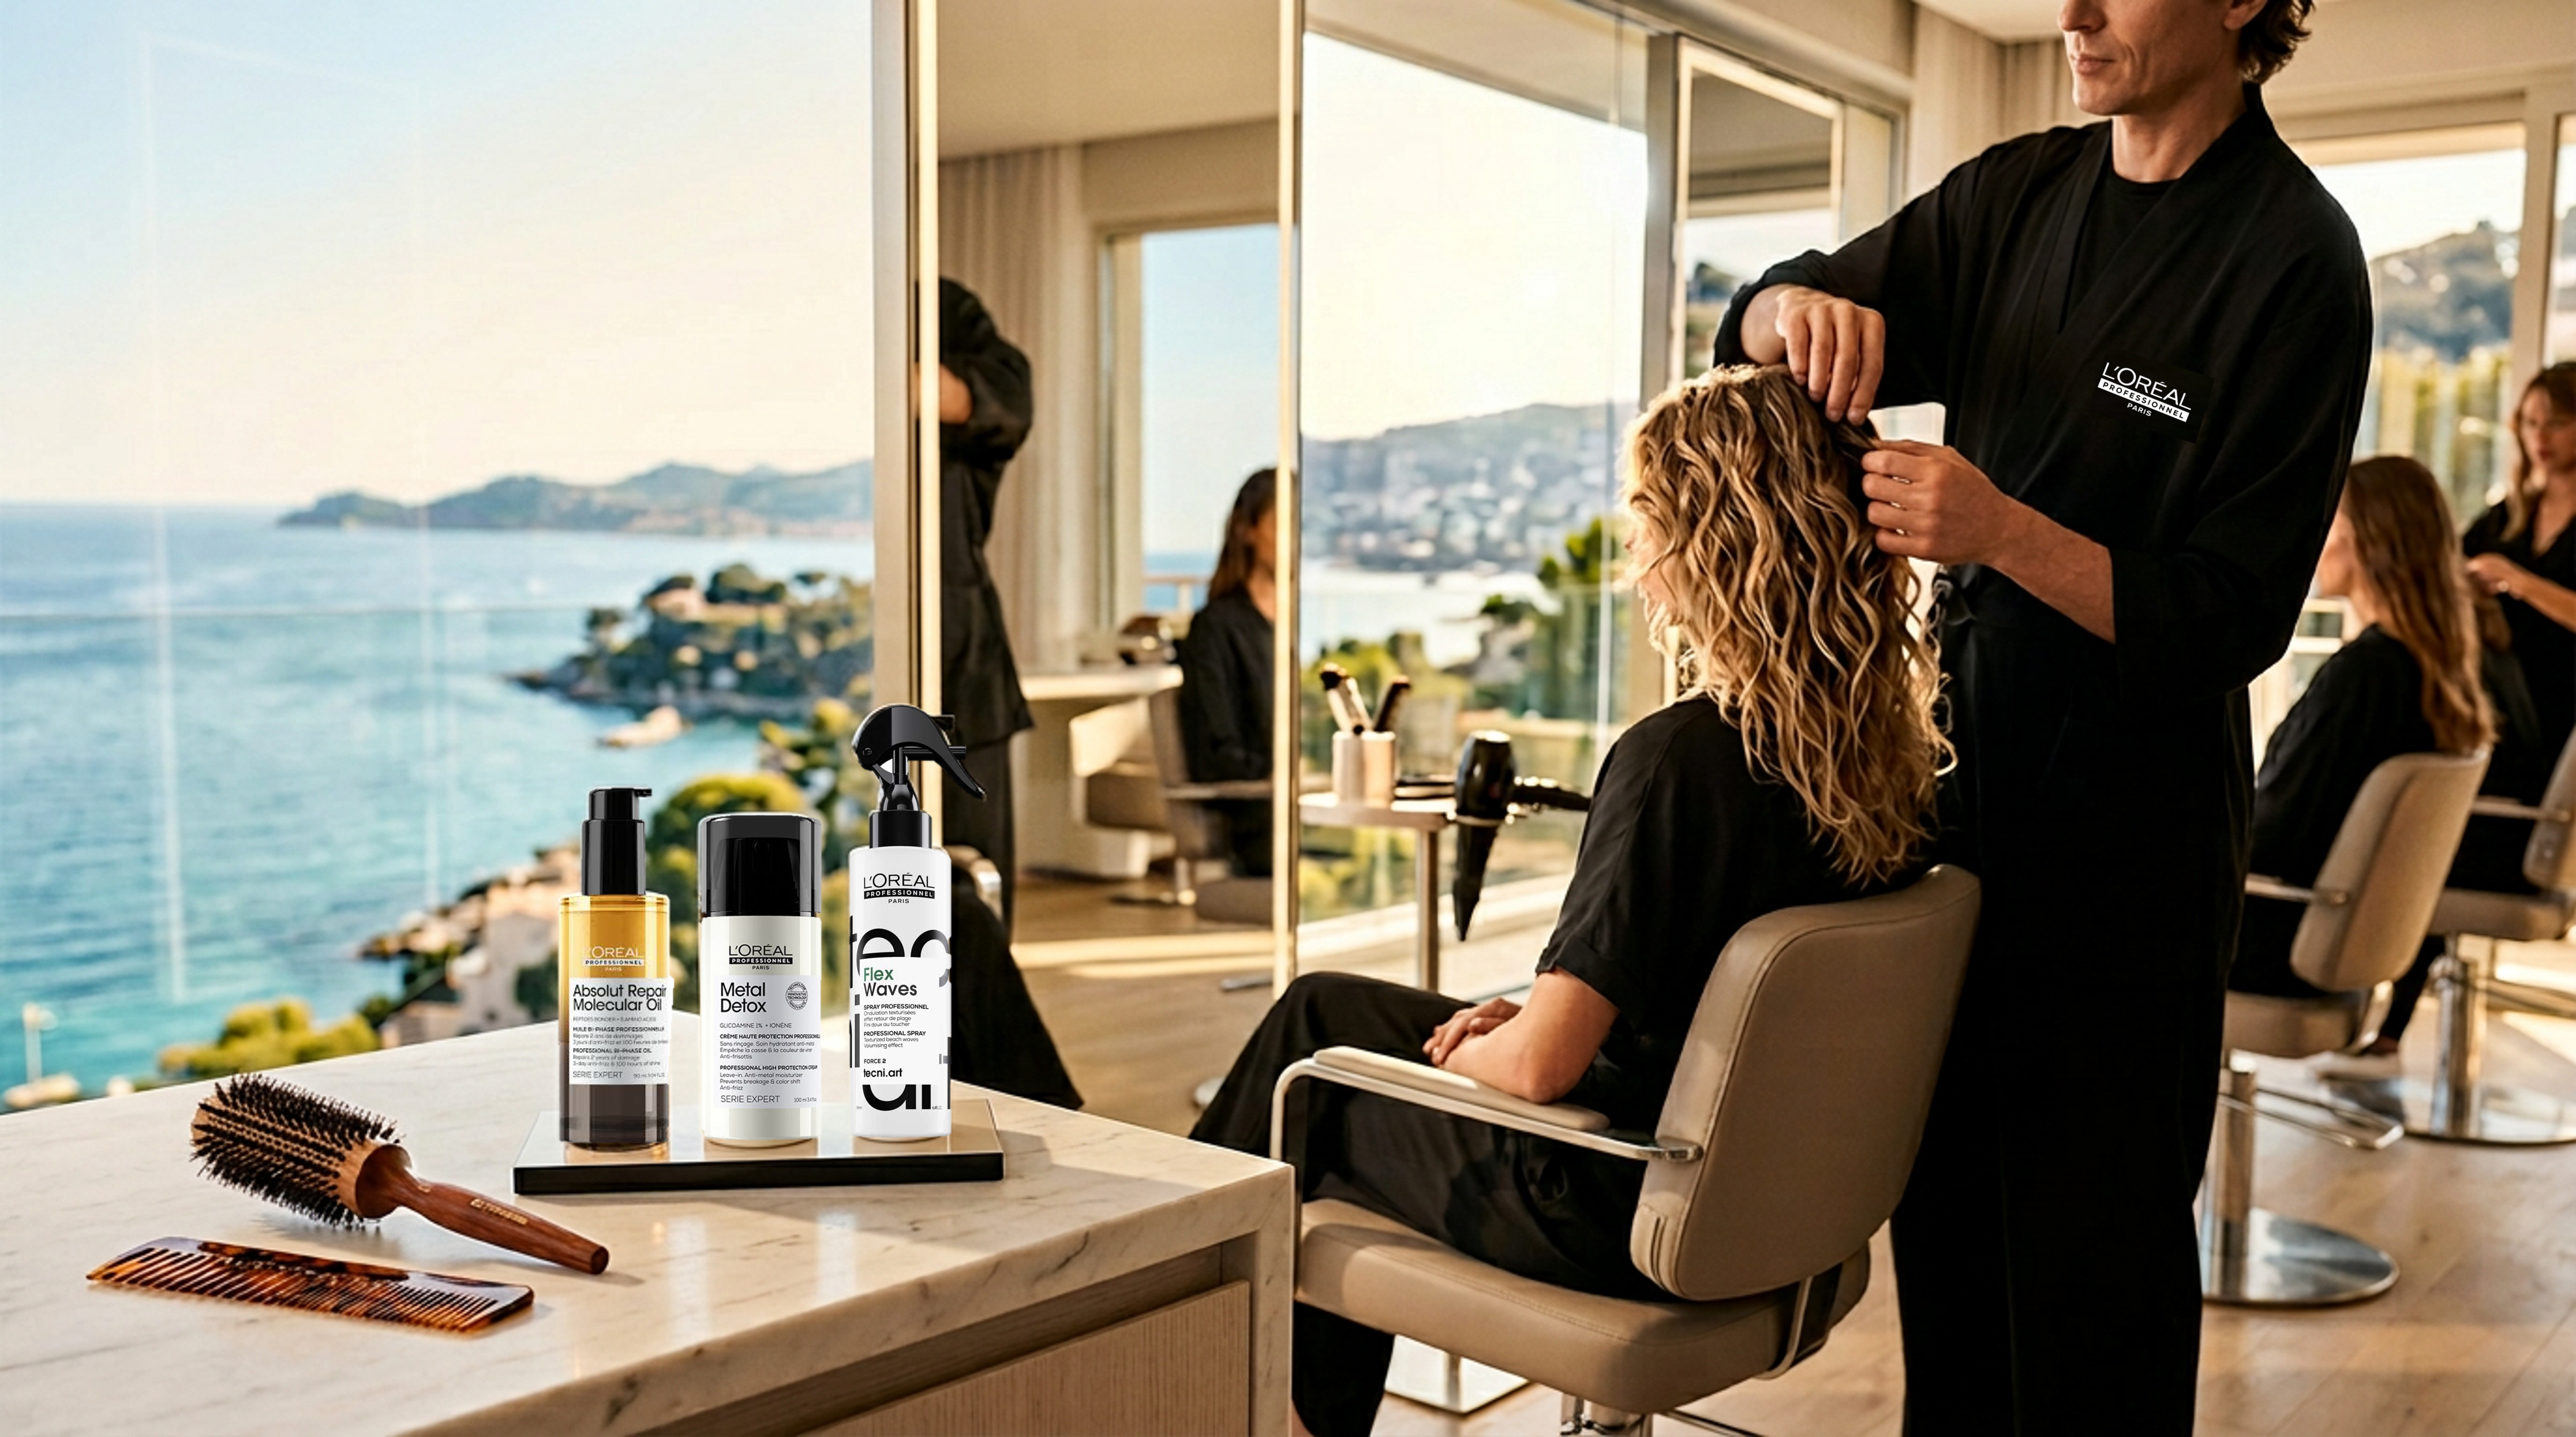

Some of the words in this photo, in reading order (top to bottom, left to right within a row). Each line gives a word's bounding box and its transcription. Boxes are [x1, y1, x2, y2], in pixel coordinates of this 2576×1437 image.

[2102, 362, 2191, 410] L'ORÉAL
[2102, 382, 2184, 419] PROFESSIONNEL
[2127, 403, 2152, 417] PARIS
[864, 872, 935, 889] L'ORÉAL
[729, 944, 793, 956] L'ORÉAL
[864, 967, 894, 982] Flex
[573, 985, 624, 997] Absolut
[628, 985, 667, 1000] Repair
[721, 982, 765, 997] Metal
[864, 982, 917, 996] Waves
[573, 999, 643, 1011] Molecular
[646, 999, 662, 1011] Oil
[721, 999, 767, 1013] Detox
[864, 1068, 903, 1078] tecni.art
